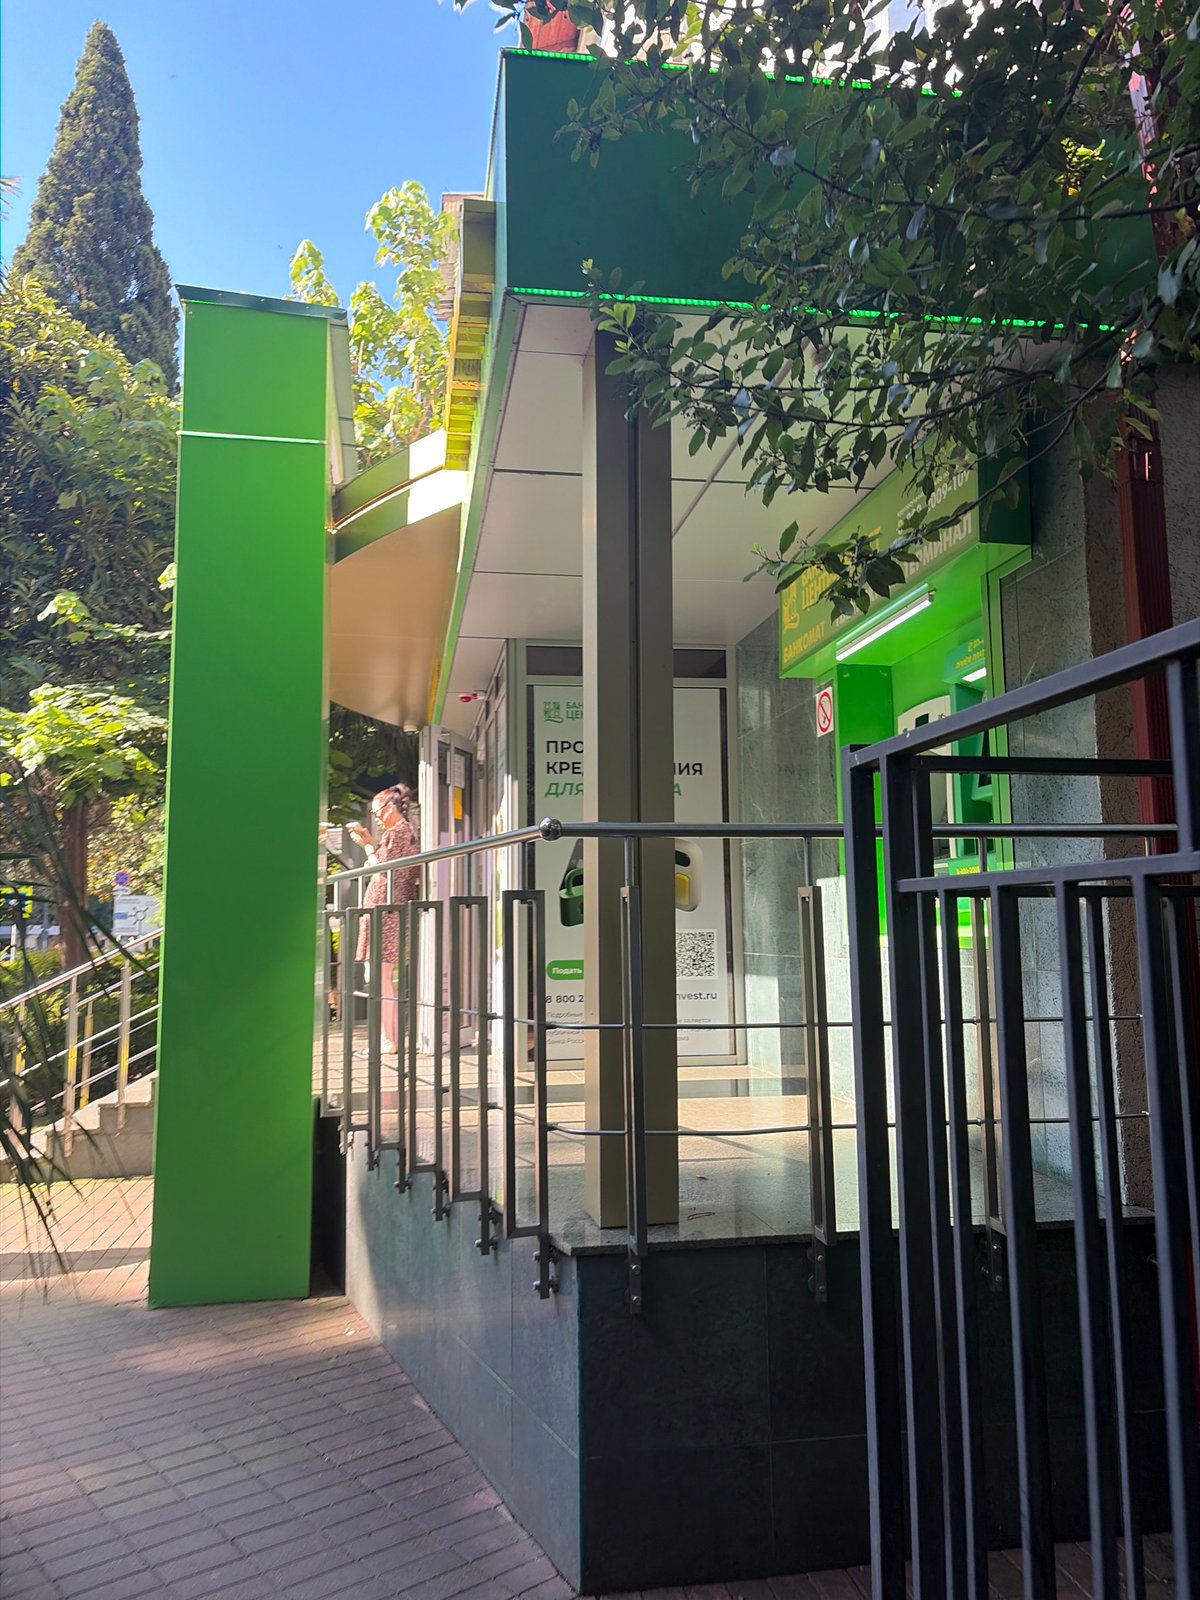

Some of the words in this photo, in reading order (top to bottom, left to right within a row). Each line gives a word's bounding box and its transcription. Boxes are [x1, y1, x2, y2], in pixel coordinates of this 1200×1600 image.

[783, 621, 826, 664] БАНКОМАТ
[546, 761, 583, 777] КРЕ
[544, 782, 583, 798] ДЛЯ
[552, 967, 582, 975] Подать
[556, 994, 575, 1003] 800
